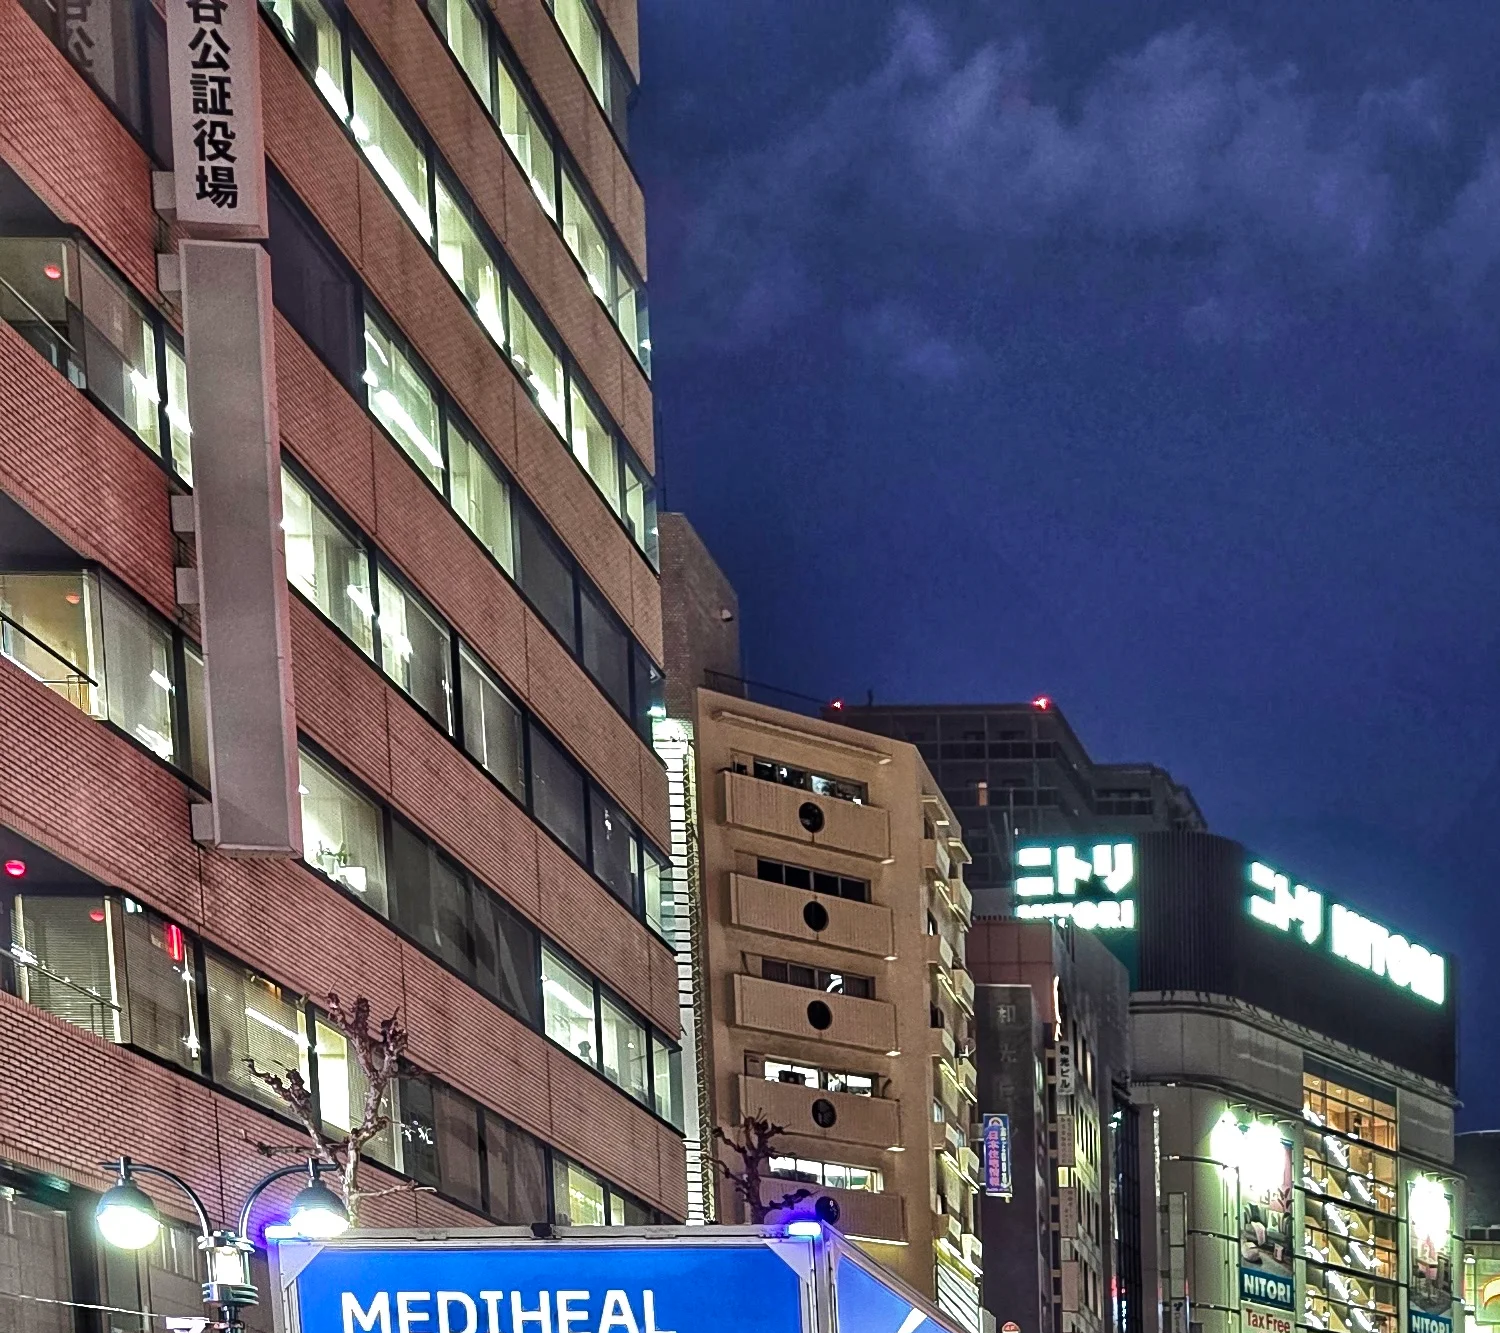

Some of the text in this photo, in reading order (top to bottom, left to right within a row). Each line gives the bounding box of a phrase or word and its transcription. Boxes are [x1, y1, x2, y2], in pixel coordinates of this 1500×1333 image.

[1015, 843, 1134, 897] ニトリ
[1250, 861, 1322, 945] ニトリ
[1244, 1273, 1291, 1304] NITORI
[1246, 1308, 1264, 1330] Tax
